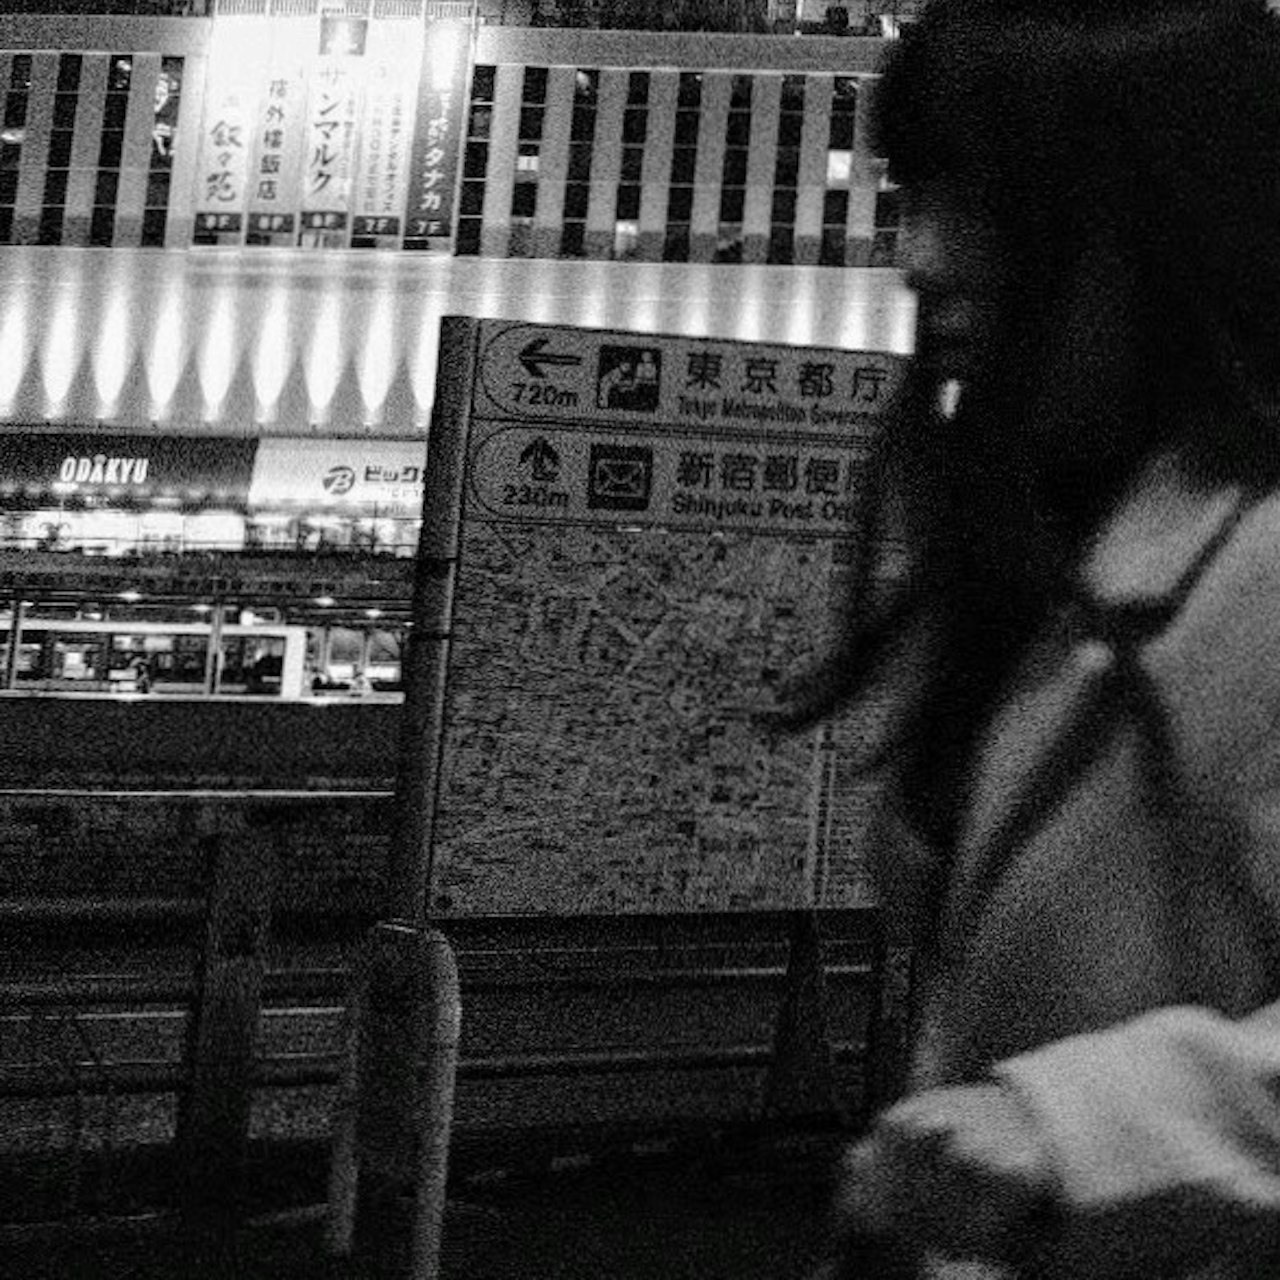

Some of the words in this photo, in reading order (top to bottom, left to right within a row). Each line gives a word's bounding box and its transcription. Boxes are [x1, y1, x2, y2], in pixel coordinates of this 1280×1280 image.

[366, 219, 388, 233] 7F
[418, 221, 442, 235] 7F
[686, 352, 887, 401] 東京都庁
[512, 383, 579, 407] 720m
[60, 454, 149, 485] ODAKYU
[672, 493, 763, 520] Shinjuku
[769, 499, 813, 520] Post
